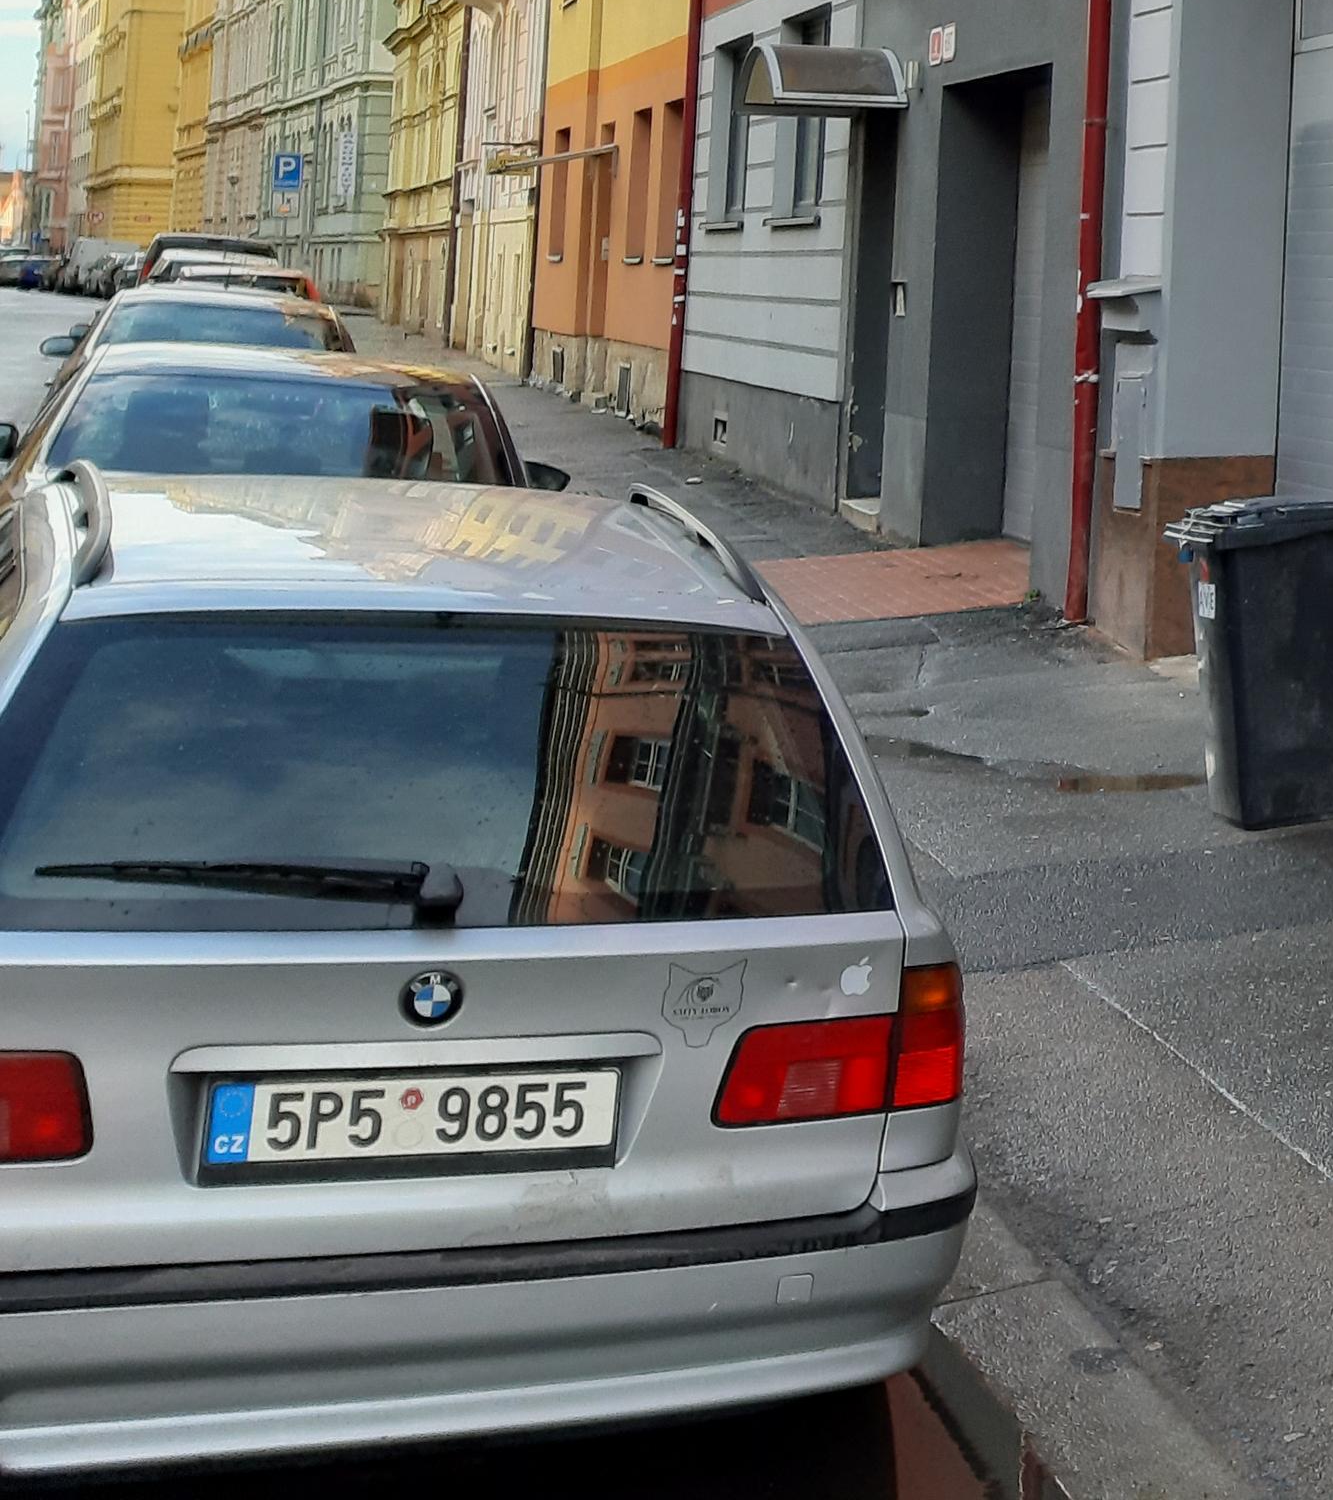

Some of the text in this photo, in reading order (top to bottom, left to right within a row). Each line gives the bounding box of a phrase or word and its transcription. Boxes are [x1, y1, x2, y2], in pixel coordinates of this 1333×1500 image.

[279, 157, 296, 178] P
[266, 1080, 588, 1152] 5P5 9855
[213, 1133, 245, 1156] CZ
